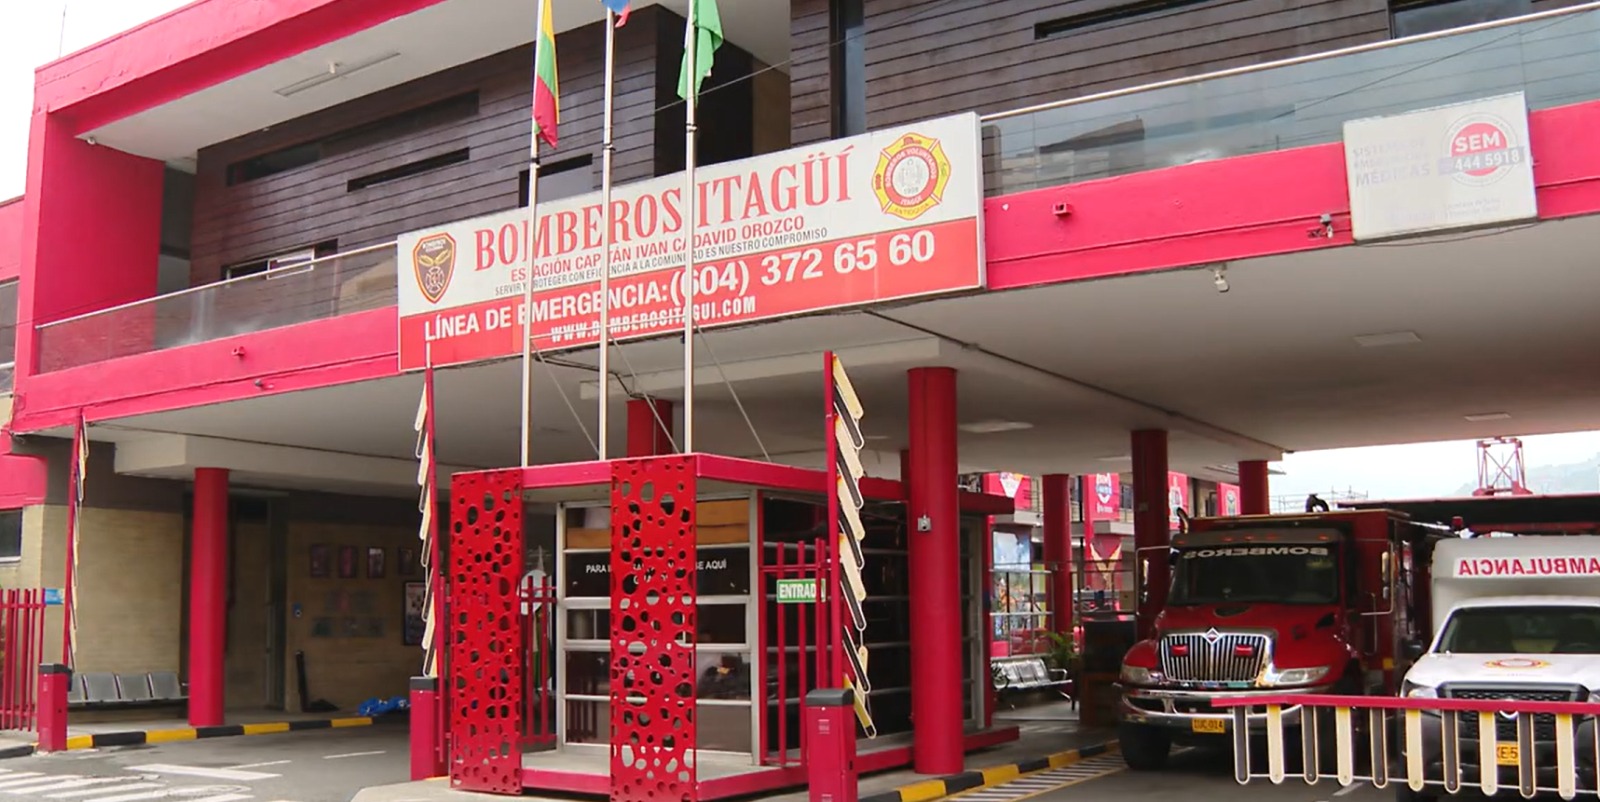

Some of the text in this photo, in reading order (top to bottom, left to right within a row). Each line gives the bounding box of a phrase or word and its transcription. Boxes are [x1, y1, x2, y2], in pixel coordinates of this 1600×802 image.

[1454, 130, 1501, 153] SEM
[1454, 149, 1520, 171] 444 5918
[474, 145, 855, 272] BOMBEROS ITAGÜÍ
[495, 281, 521, 296] SERVIR
[527, 273, 567, 289] ROTEGER
[568, 270, 585, 283] CON
[586, 262, 630, 279] EFICNCIA
[640, 259, 651, 270] LA
[652, 249, 704, 266] COMUNIAD
[706, 246, 717, 258] ES
[718, 238, 761, 256] NUESTRO
[761, 226, 828, 249] COMPROMISO
[511, 257, 572, 282] ESACIÓN
[575, 246, 631, 270] CAPTÁN
[636, 240, 668, 259] IVAN
[741, 215, 805, 240] OROZCO
[424, 313, 480, 342] LÍNEA
[484, 306, 512, 331] DE
[760, 248, 824, 286] 372
[833, 238, 878, 275] 65
[888, 229, 935, 266] 60
[550, 295, 757, 343] WWW.BMBEROSITGUI.COM
[585, 564, 607, 574] PARA
[704, 558, 728, 571] AQUÍ
